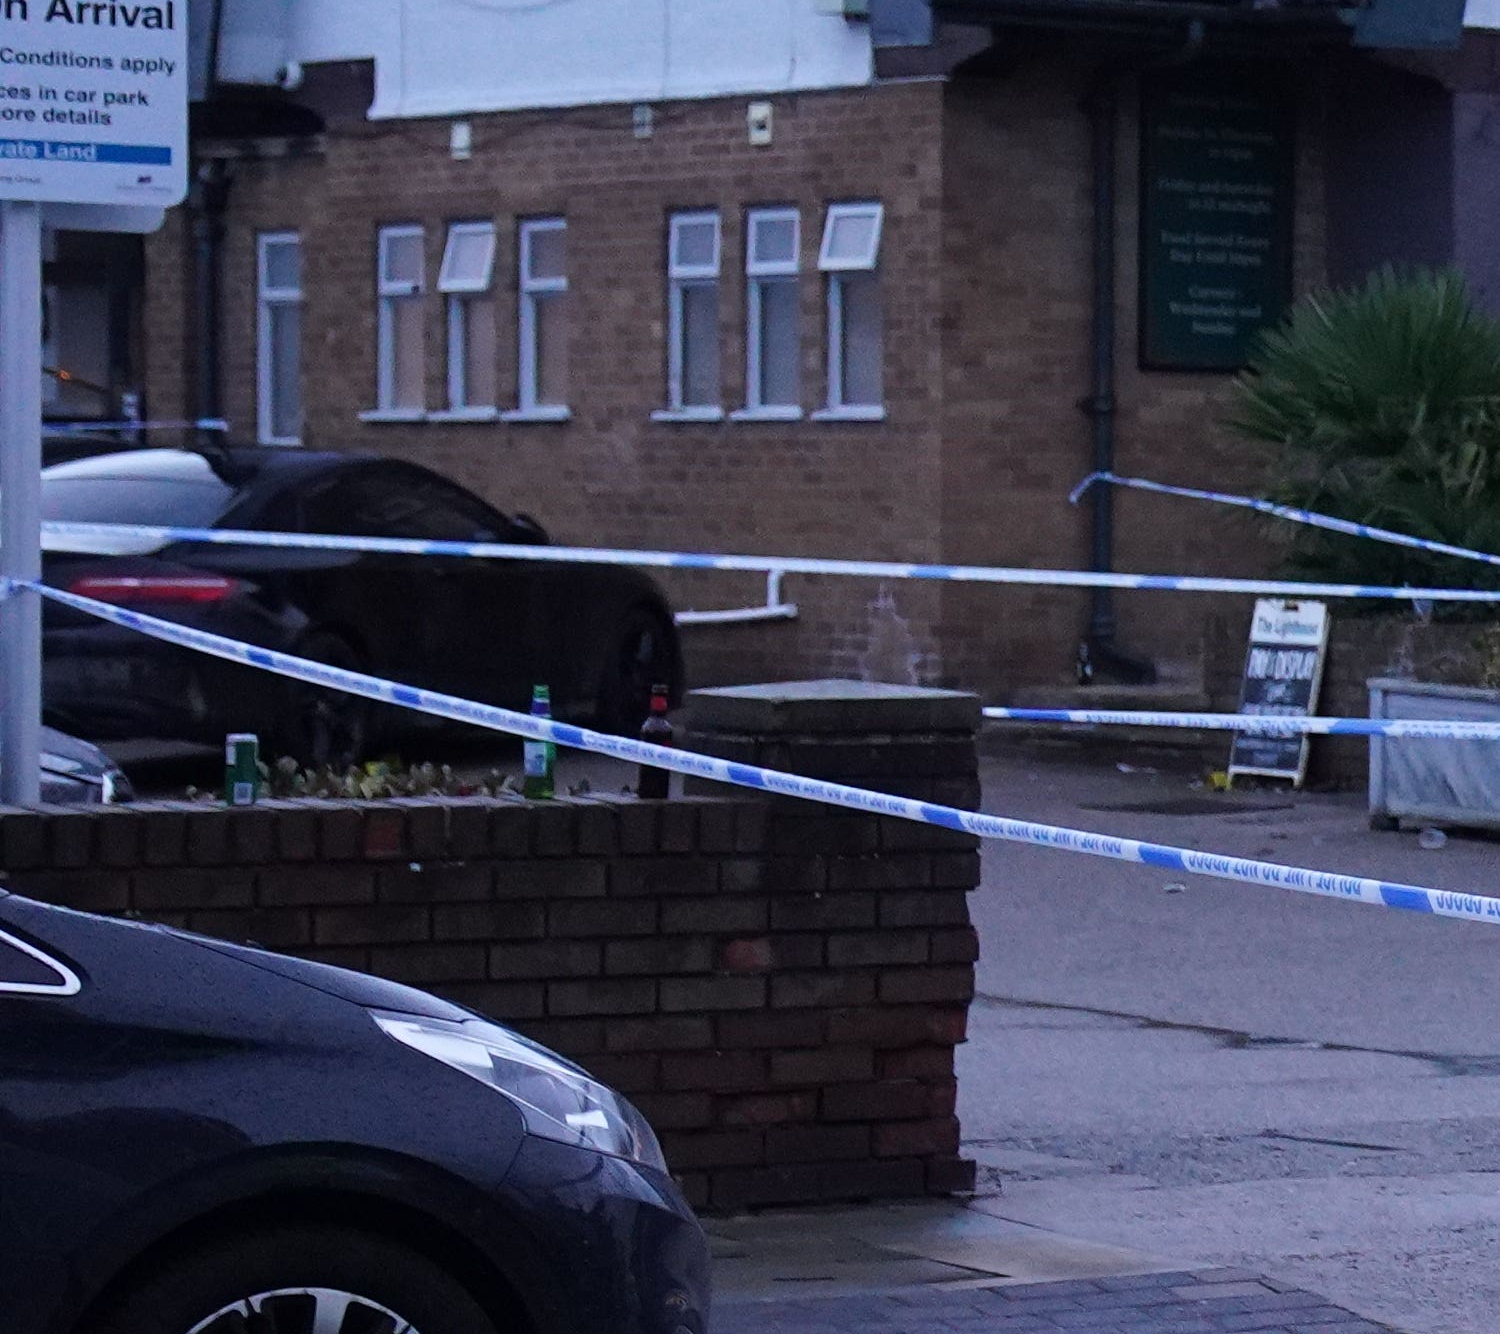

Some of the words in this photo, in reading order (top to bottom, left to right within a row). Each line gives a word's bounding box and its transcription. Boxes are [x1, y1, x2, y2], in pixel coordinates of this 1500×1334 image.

[0, 47, 114, 69] Conditions
[120, 57, 176, 77] apply
[38, 84, 57, 101] in
[64, 89, 97, 104] car
[103, 89, 150, 107] park
[42, 107, 112, 126] details
[0, 141, 38, 159] ate
[44, 142, 97, 162] Land
